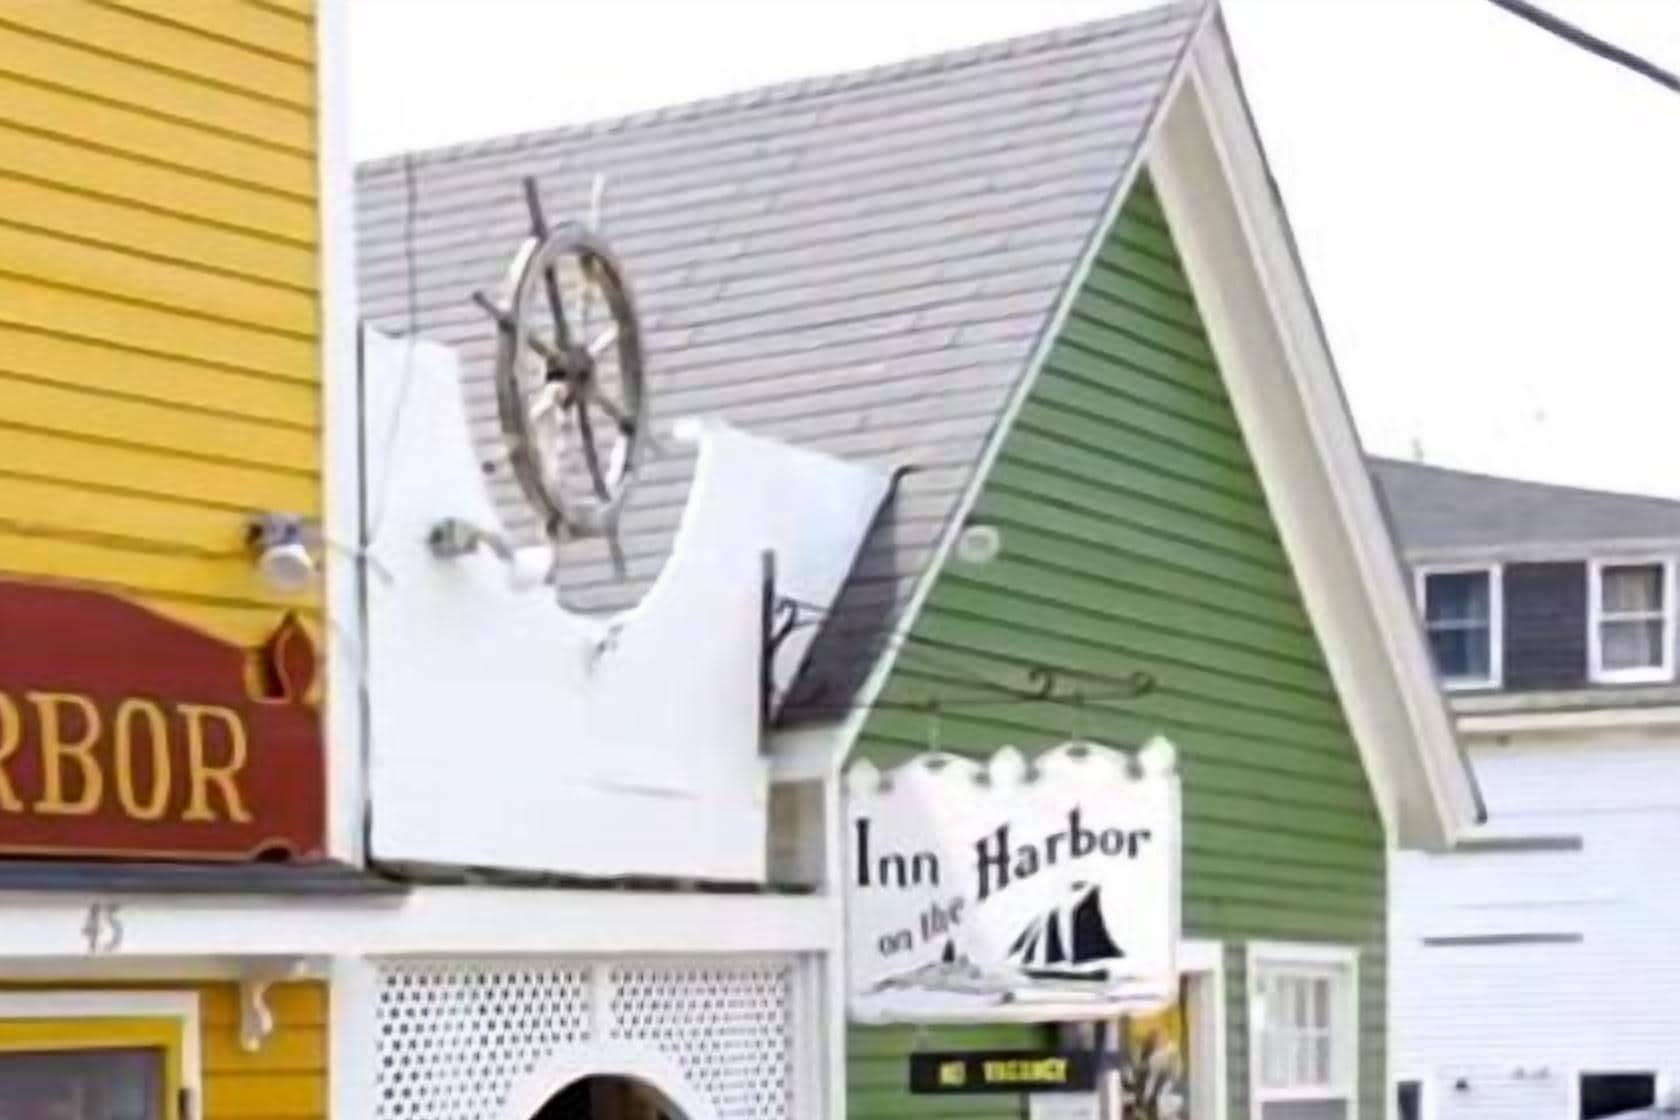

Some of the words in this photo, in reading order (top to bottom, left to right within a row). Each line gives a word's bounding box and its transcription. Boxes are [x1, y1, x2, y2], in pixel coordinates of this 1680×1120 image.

[855, 817, 940, 888] Inn
[877, 928, 913, 957] on
[920, 897, 965, 943] the
[975, 804, 1152, 902] Harbor
[81, 902, 124, 951] 45
